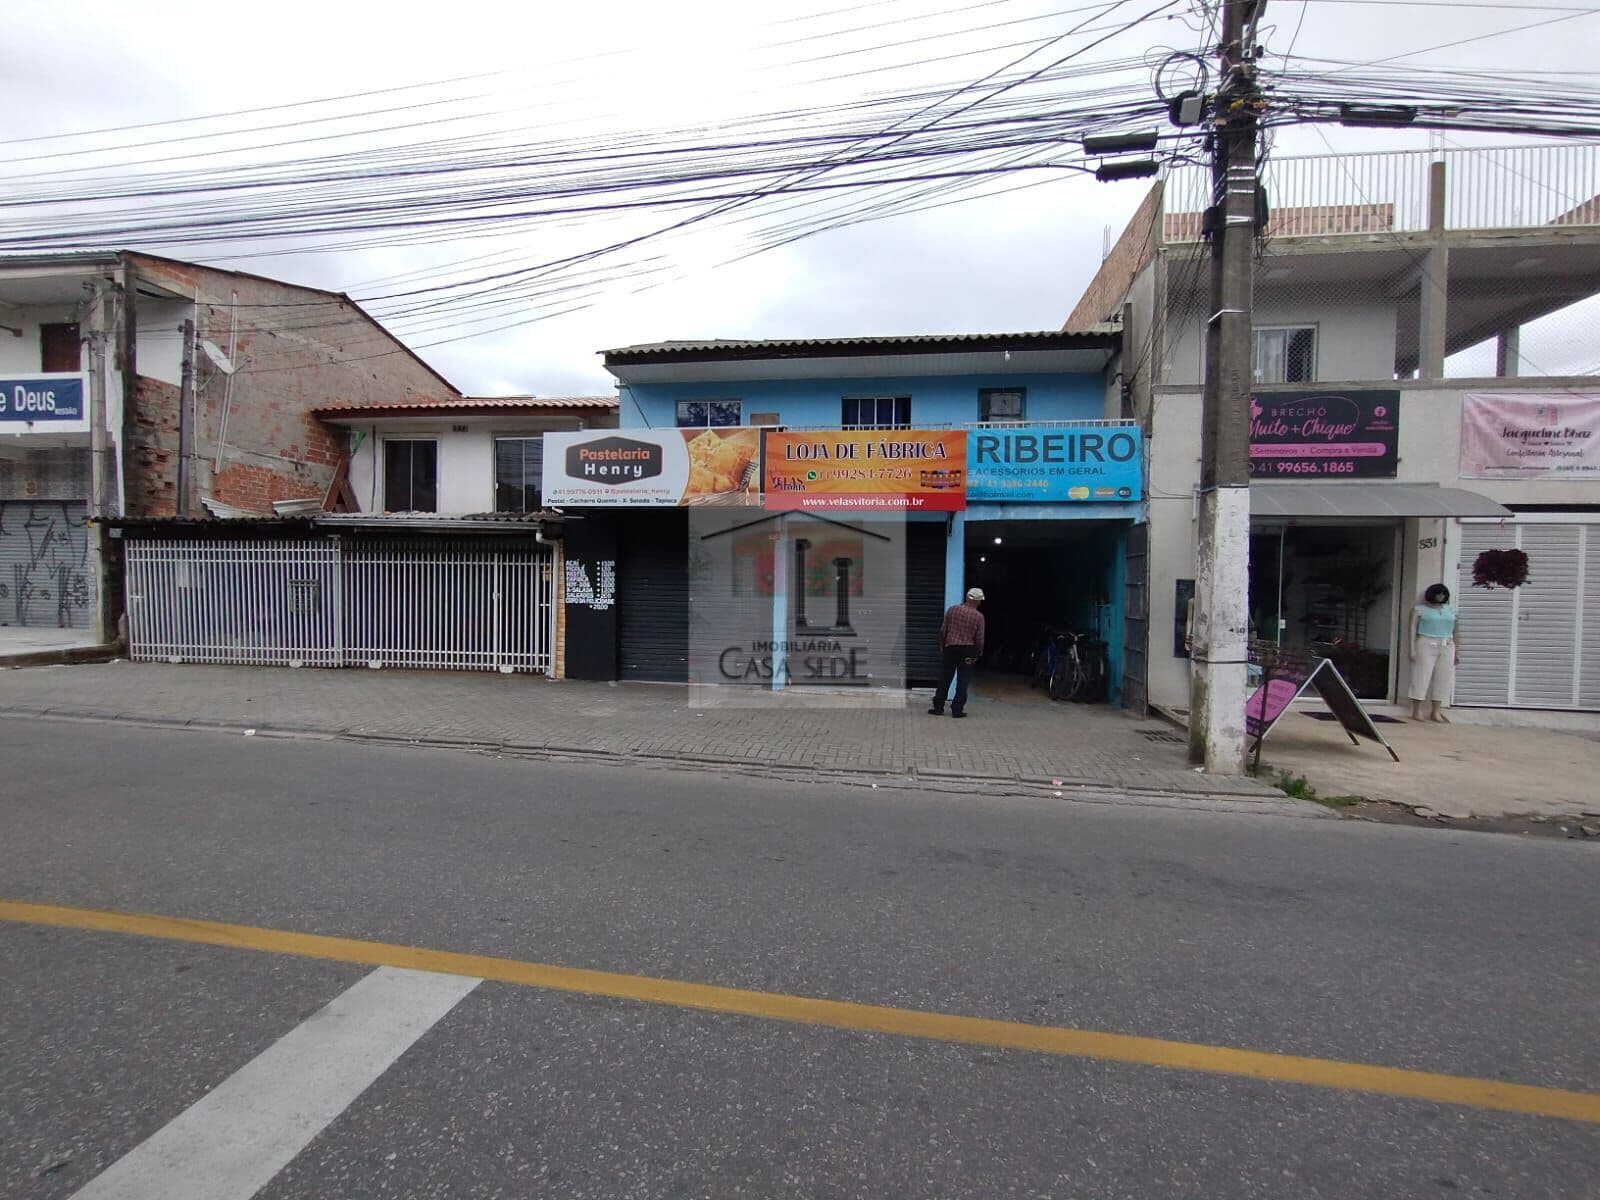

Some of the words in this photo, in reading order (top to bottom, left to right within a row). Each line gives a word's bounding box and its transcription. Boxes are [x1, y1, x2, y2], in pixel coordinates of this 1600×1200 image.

[14, 385, 56, 412] Deus
[1271, 406, 1328, 418] BRECHÓ
[1301, 417, 1354, 441] Chique
[1501, 427, 1562, 441] Jacqueline
[579, 447, 650, 461] Pastelaria
[785, 441, 830, 461] LOJA
[835, 441, 860, 460] DE
[866, 437, 947, 460] FÁBRICA
[976, 433, 1137, 464] RIBEIRO
[1254, 447, 1298, 455] Seminovos
[1310, 446, 1346, 456] Compra
[583, 463, 643, 478] Henry
[1048, 467, 1065, 476] EM
[1067, 466, 1106, 476] GERAL
[1257, 463, 1273, 472] 41
[1276, 461, 1355, 473] 99656.1865
[596, 497, 618, 505] Quente
[655, 497, 678, 505] Tapioca
[801, 496, 925, 508] www.velasvitoria.com.br
